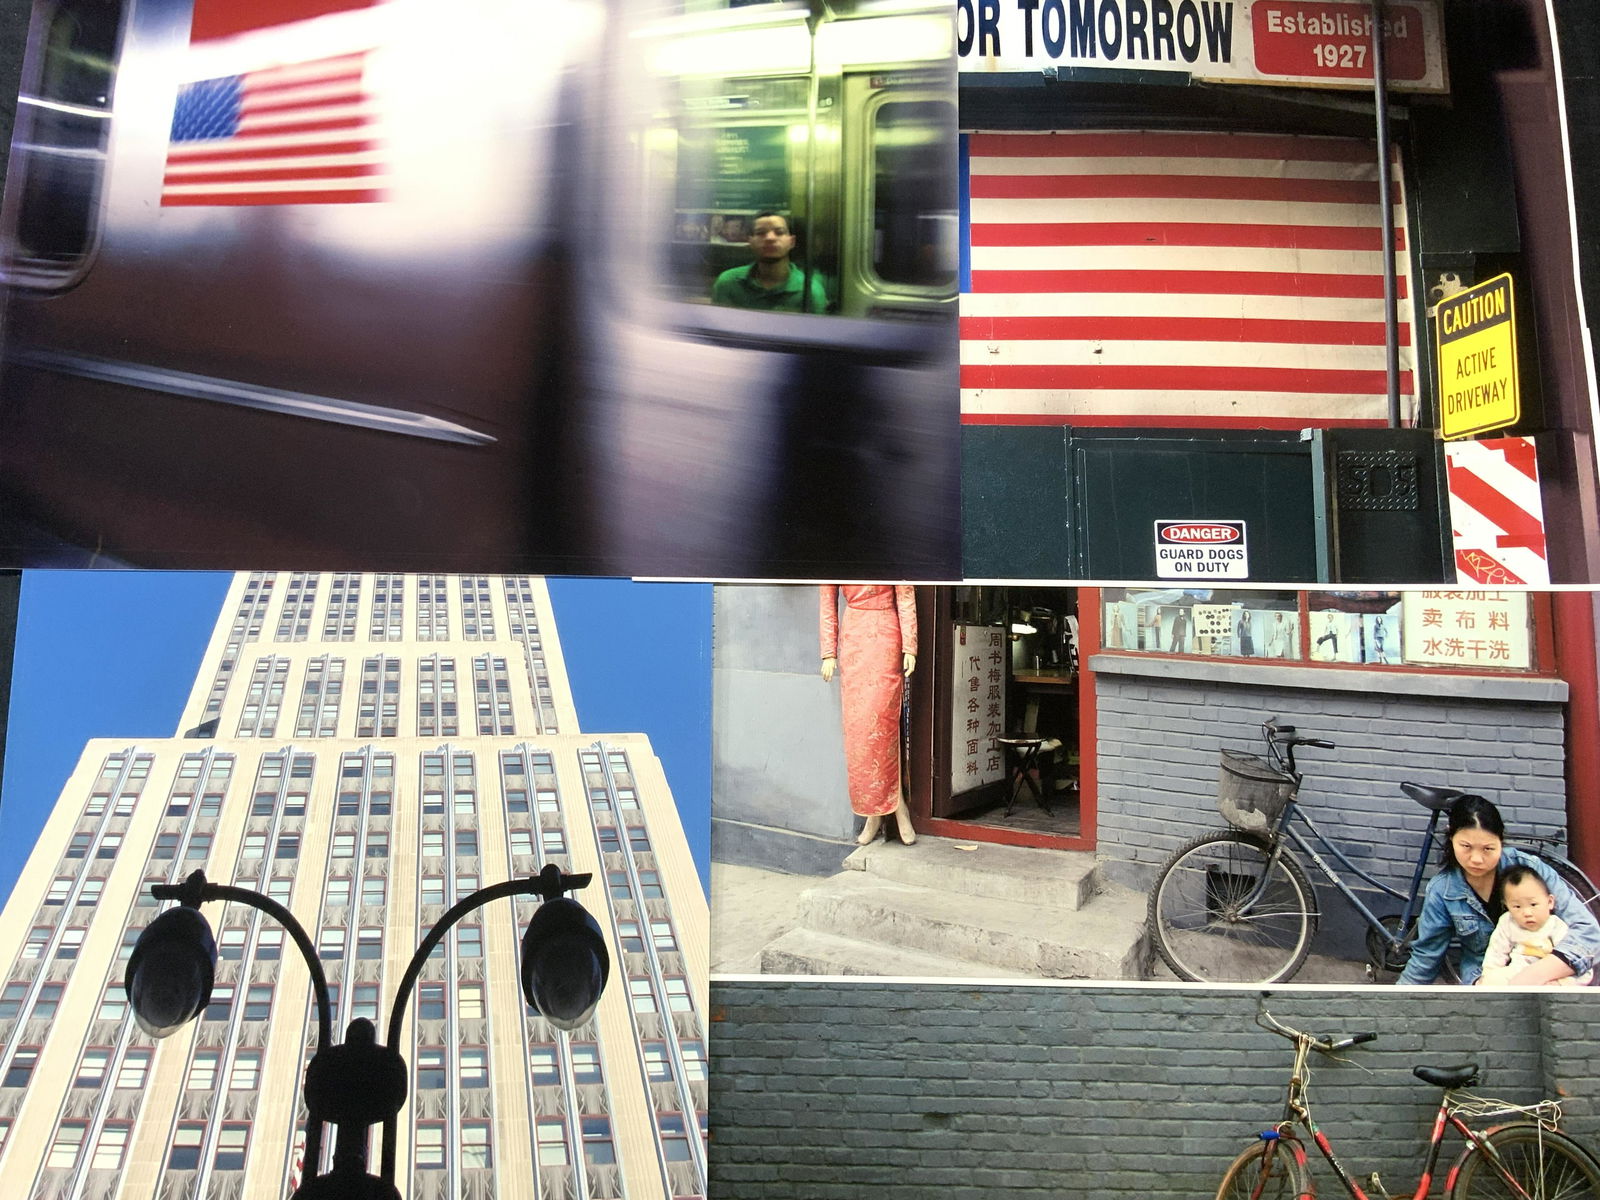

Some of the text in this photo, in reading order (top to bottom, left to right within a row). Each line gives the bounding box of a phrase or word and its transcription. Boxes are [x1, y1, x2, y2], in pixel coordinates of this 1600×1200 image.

[958, 0, 1234, 63] OR TOMORROW
[1313, 44, 1367, 68] 1927
[1443, 286, 1506, 335] CAUTION
[1456, 346, 1497, 379] ACTIVE
[1447, 377, 1507, 415] DRIVEWAY
[1169, 527, 1232, 540] DANGER
[1160, 549, 1244, 560] GUARD DOGS
[1174, 562, 1230, 573] ON DUTY
[1422, 637, 1510, 660] 水洗干洗
[986, 633, 1003, 772] 周书梅服装加工店
